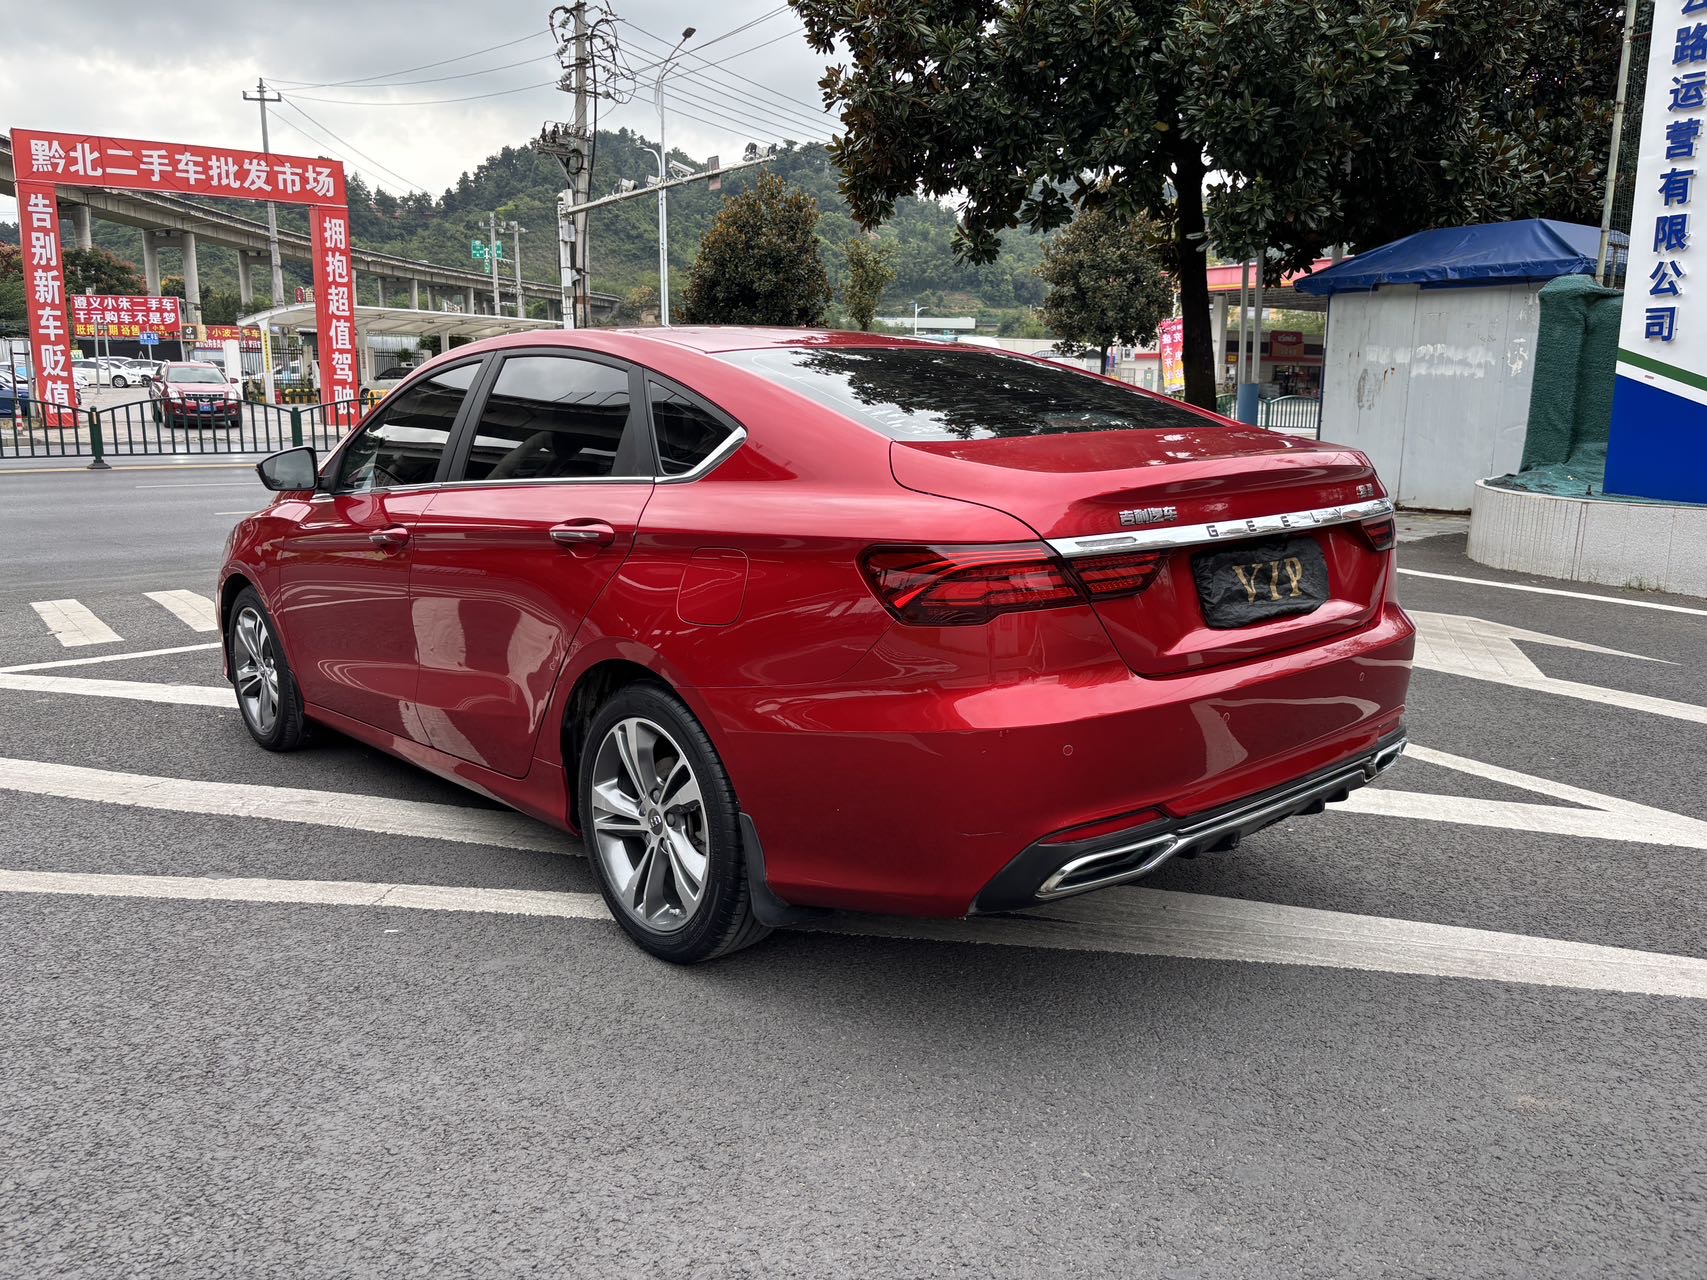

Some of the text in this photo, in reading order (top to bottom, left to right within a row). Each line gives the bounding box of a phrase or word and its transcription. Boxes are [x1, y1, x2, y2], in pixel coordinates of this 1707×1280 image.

[30, 138, 335, 198] 黔北二手车批发市场
[27, 193, 73, 414] 告别新车贬值
[74, 296, 175, 311] 遵义小朱二手车
[75, 310, 176, 325] 千元购车不是梦
[323, 216, 355, 415] 拥抱超值驾驶
[1119, 507, 1178, 526] 吉利汽车
[1206, 507, 1343, 538] GEELY
[1232, 557, 1303, 606] VIP
